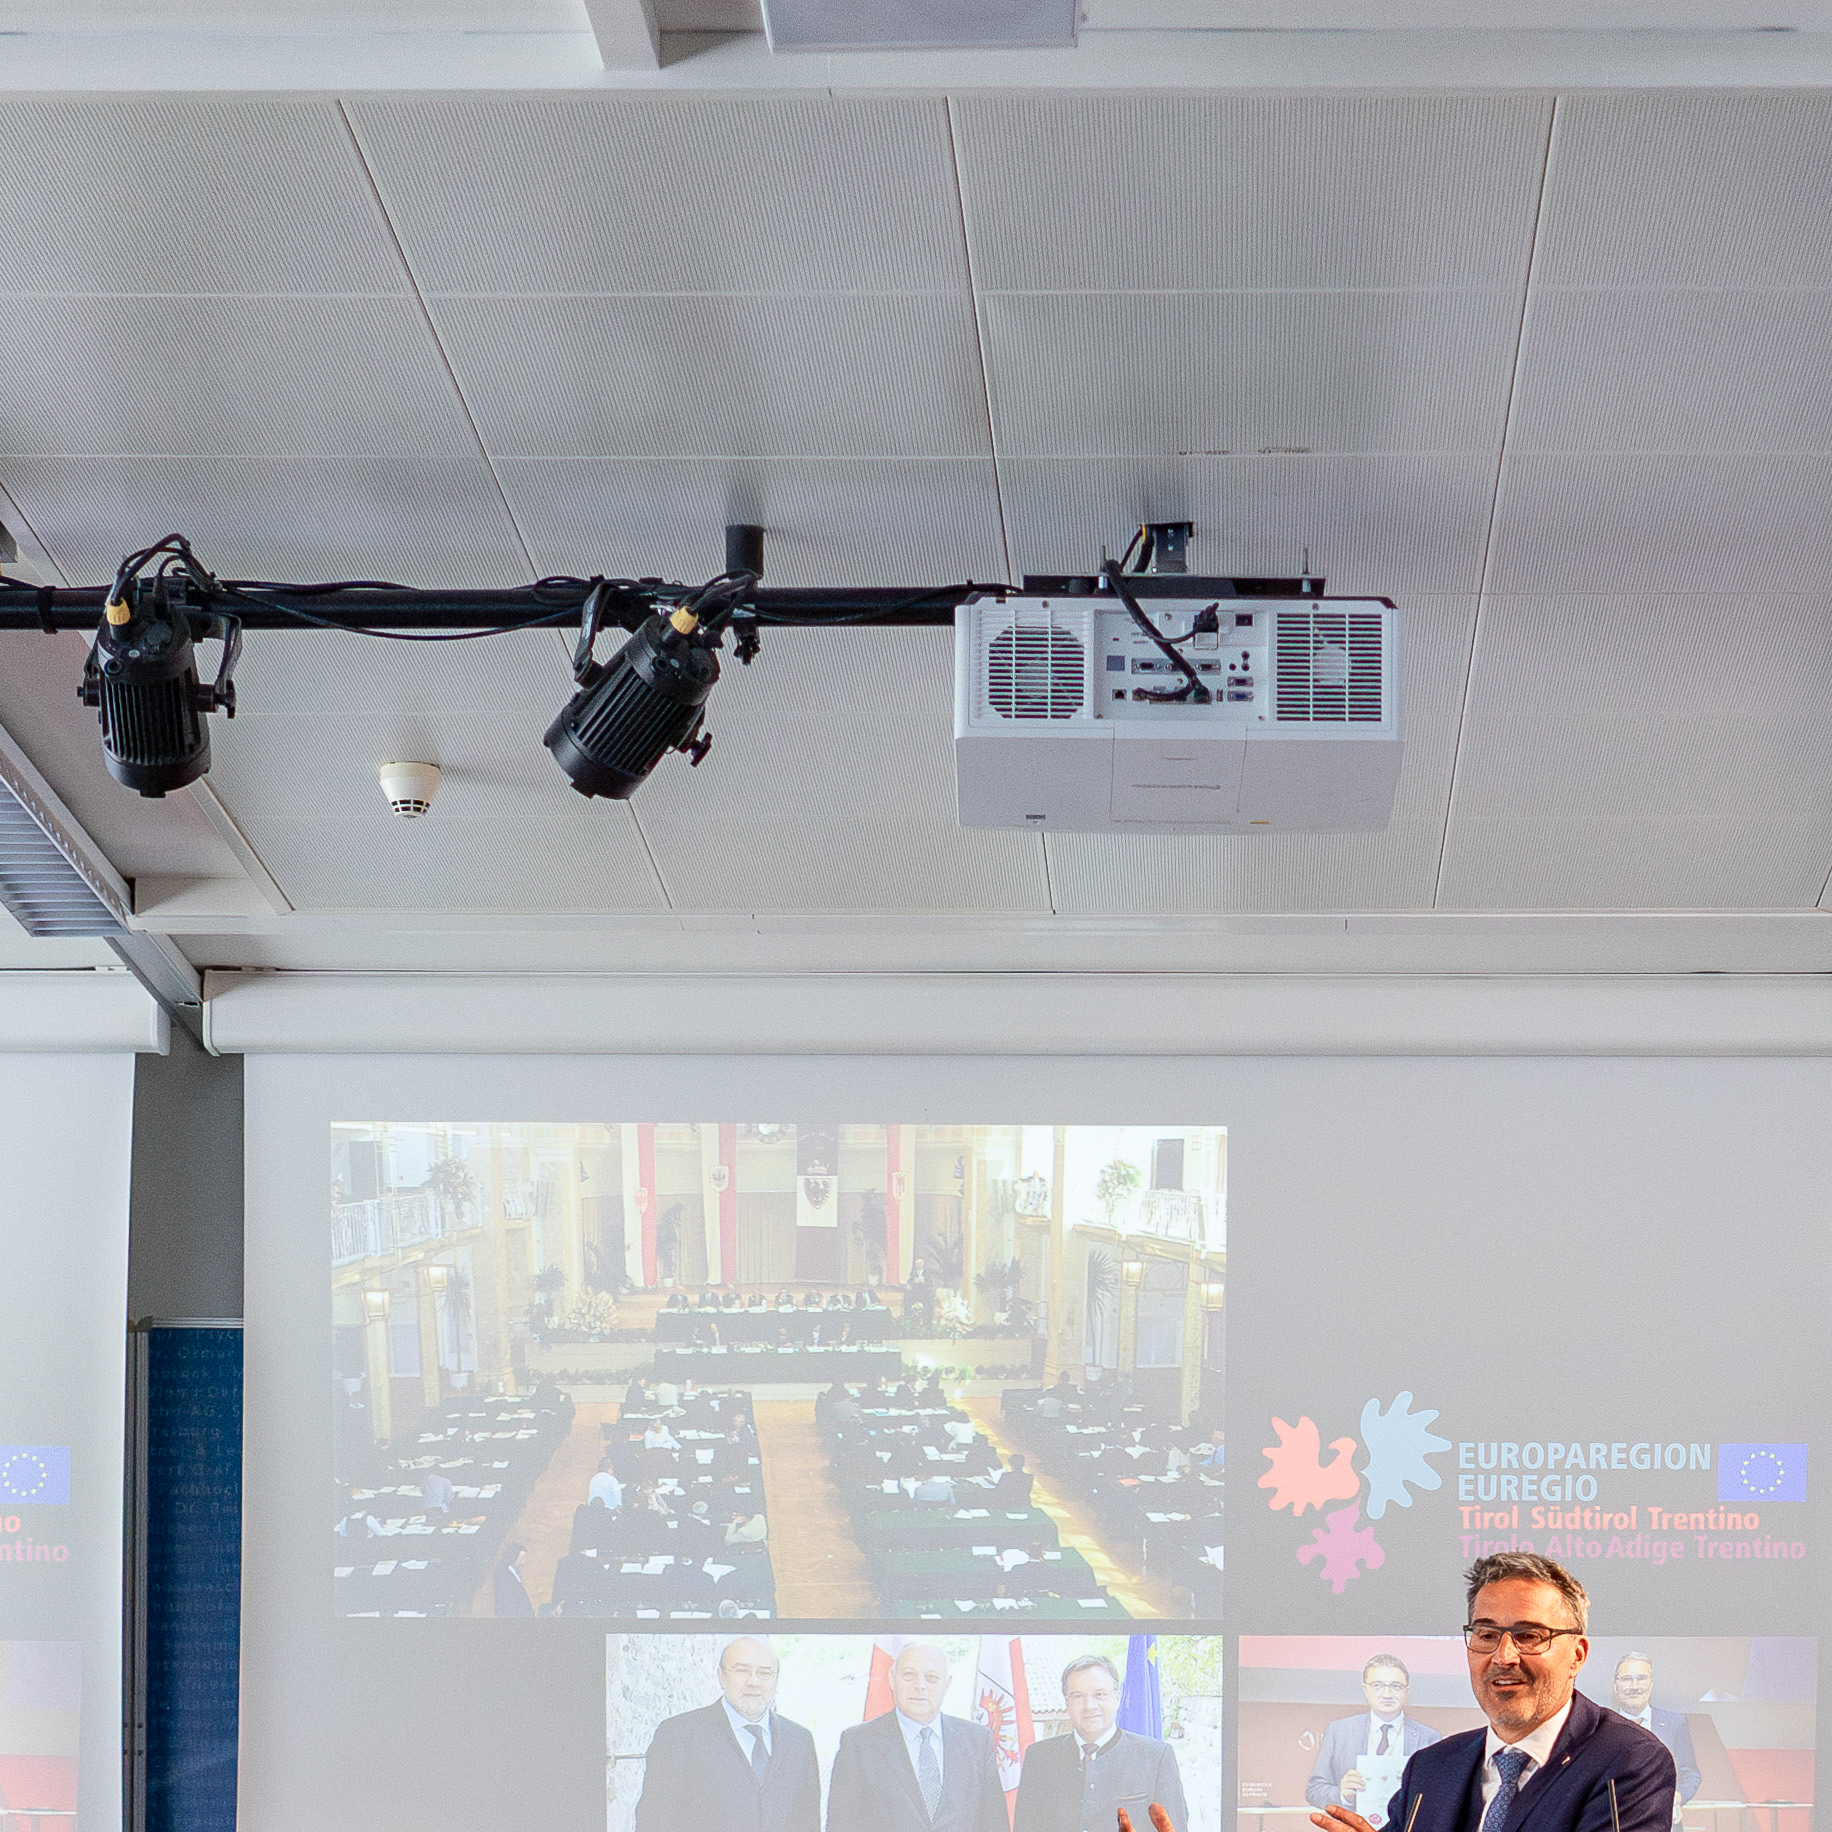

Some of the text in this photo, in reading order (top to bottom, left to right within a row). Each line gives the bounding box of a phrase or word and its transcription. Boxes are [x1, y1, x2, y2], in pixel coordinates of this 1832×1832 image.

[1458, 1442, 1711, 1470] EUROPAREGION
[1458, 1474, 1598, 1501] EUREGIO
[1459, 1505, 1760, 1530] Tirol Südtirol Trentino
[1545, 1535, 1603, 1558] Alto
[1605, 1535, 1684, 1564] Adige
[1694, 1535, 1806, 1559] Trentino
